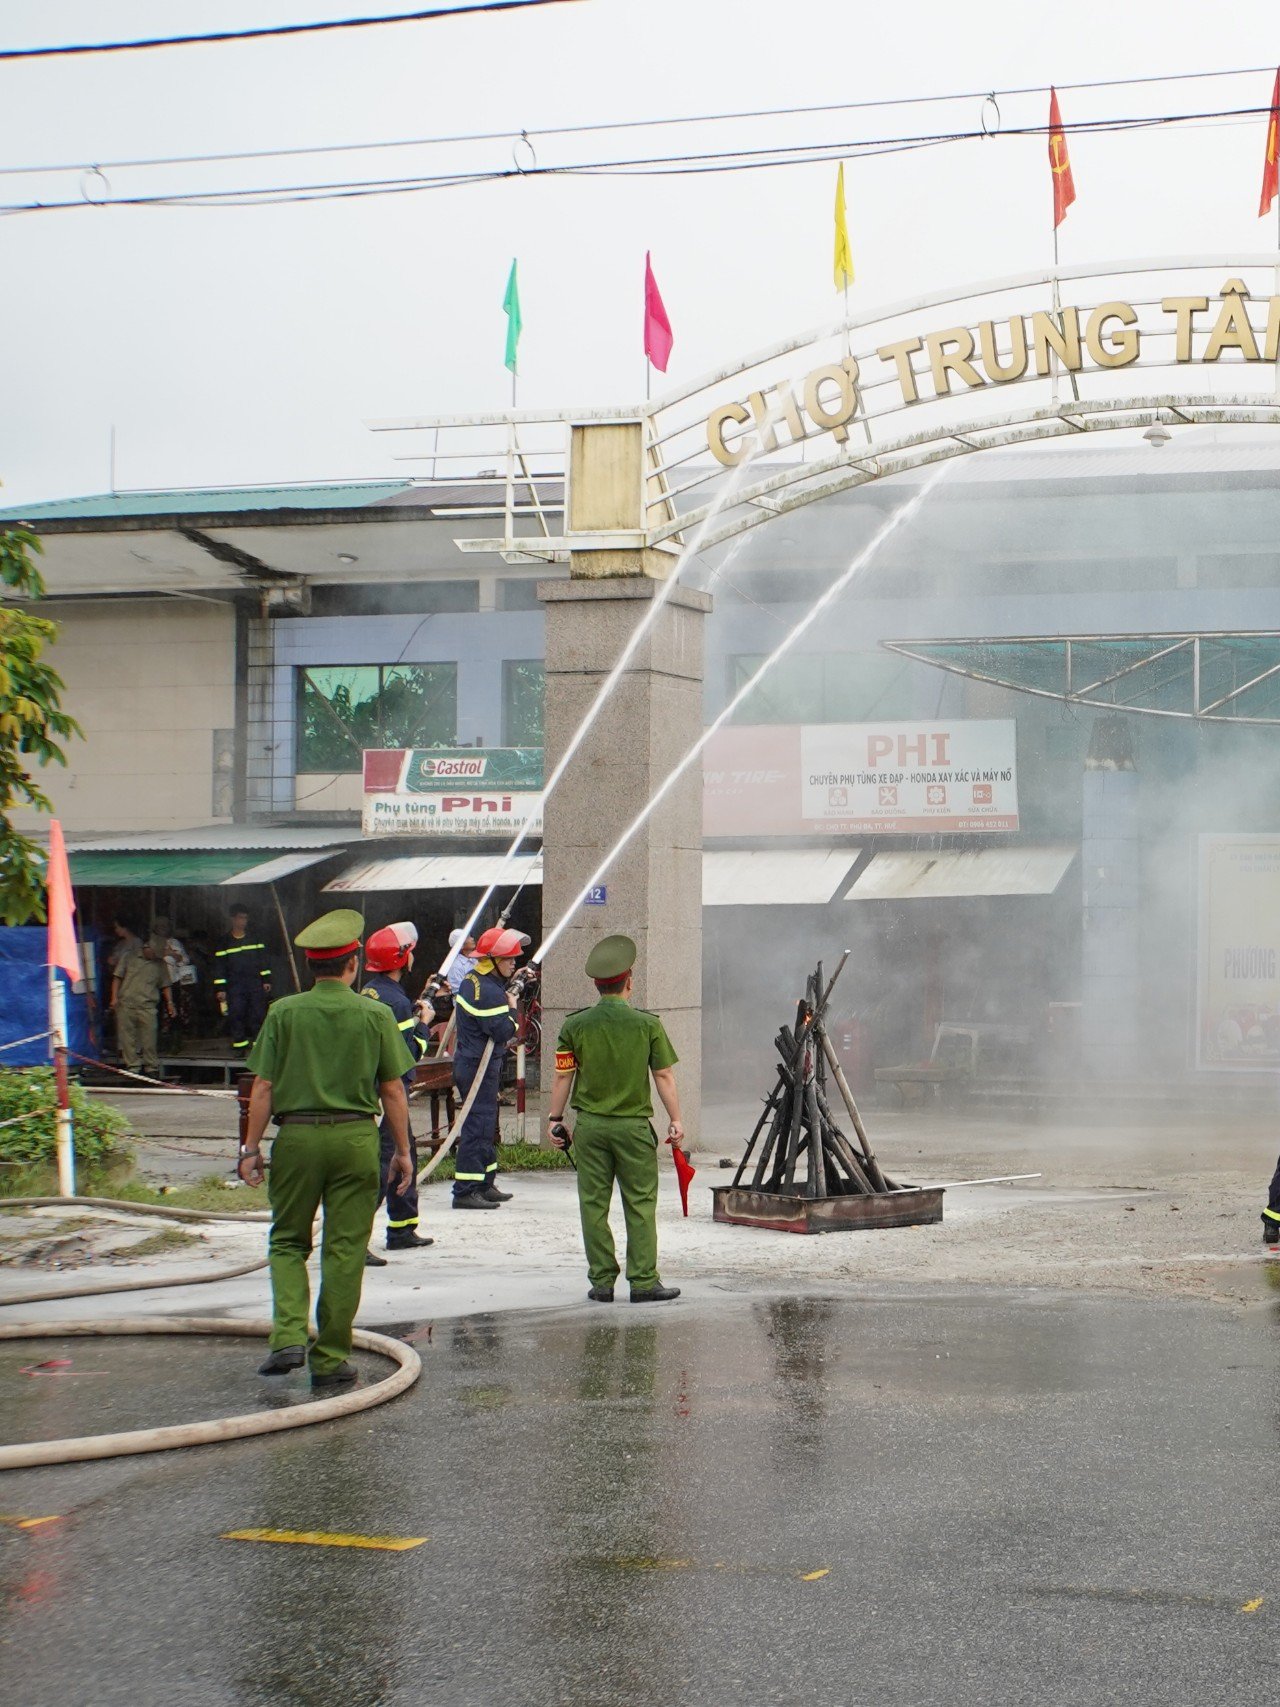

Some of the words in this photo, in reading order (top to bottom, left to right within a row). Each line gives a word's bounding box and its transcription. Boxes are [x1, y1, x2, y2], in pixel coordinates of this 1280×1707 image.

[706, 356, 859, 466] CHỢ
[877, 301, 1140, 404] TRUNG
[867, 733, 951, 767] PHI
[436, 760, 482, 775] Castrol
[809, 771, 838, 786] CHUYÊN
[840, 774, 855, 787] PHỤ
[857, 770, 877, 785] TÙNG
[879, 773, 888, 784] XE
[889, 773, 904, 787] ĐẠP
[910, 772, 937, 783] HONDA
[938, 772, 953, 783] XAY
[954, 768, 969, 783] XÁC
[970, 768, 981, 782] VÀ
[982, 767, 999, 782] MÁY
[375, 802, 401, 816] Phụ
[405, 802, 436, 815] tùng
[442, 796, 512, 813] Phi
[589, 888, 602, 899] 12
